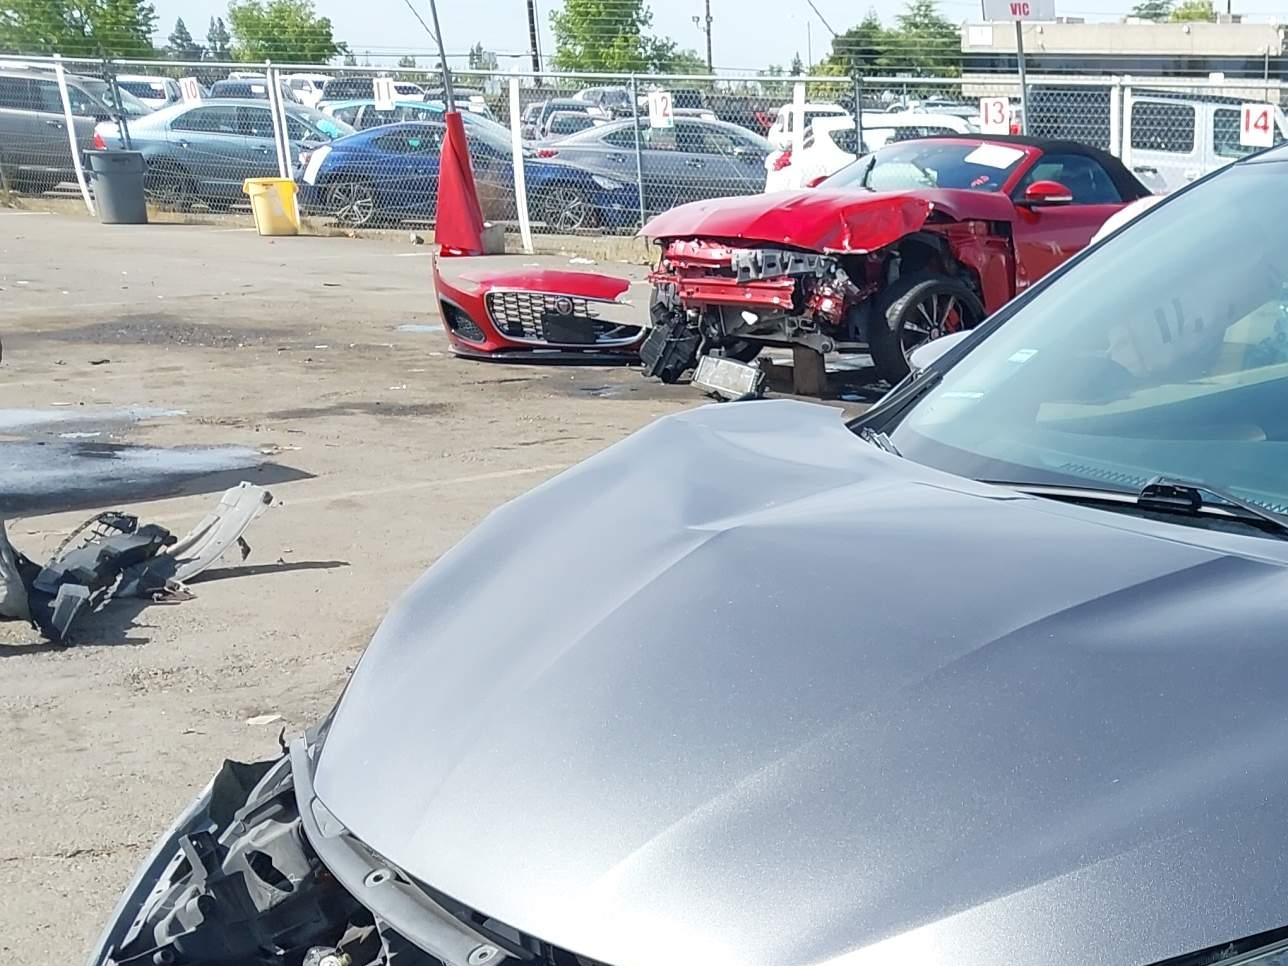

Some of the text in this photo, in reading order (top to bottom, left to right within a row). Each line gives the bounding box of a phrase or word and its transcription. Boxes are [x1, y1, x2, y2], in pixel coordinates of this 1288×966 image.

[1009, 2, 1030, 16] VIC
[184, 80, 198, 99] 10
[653, 95, 670, 117] 12
[984, 101, 1005, 125] 13
[1245, 109, 1269, 133] 14
